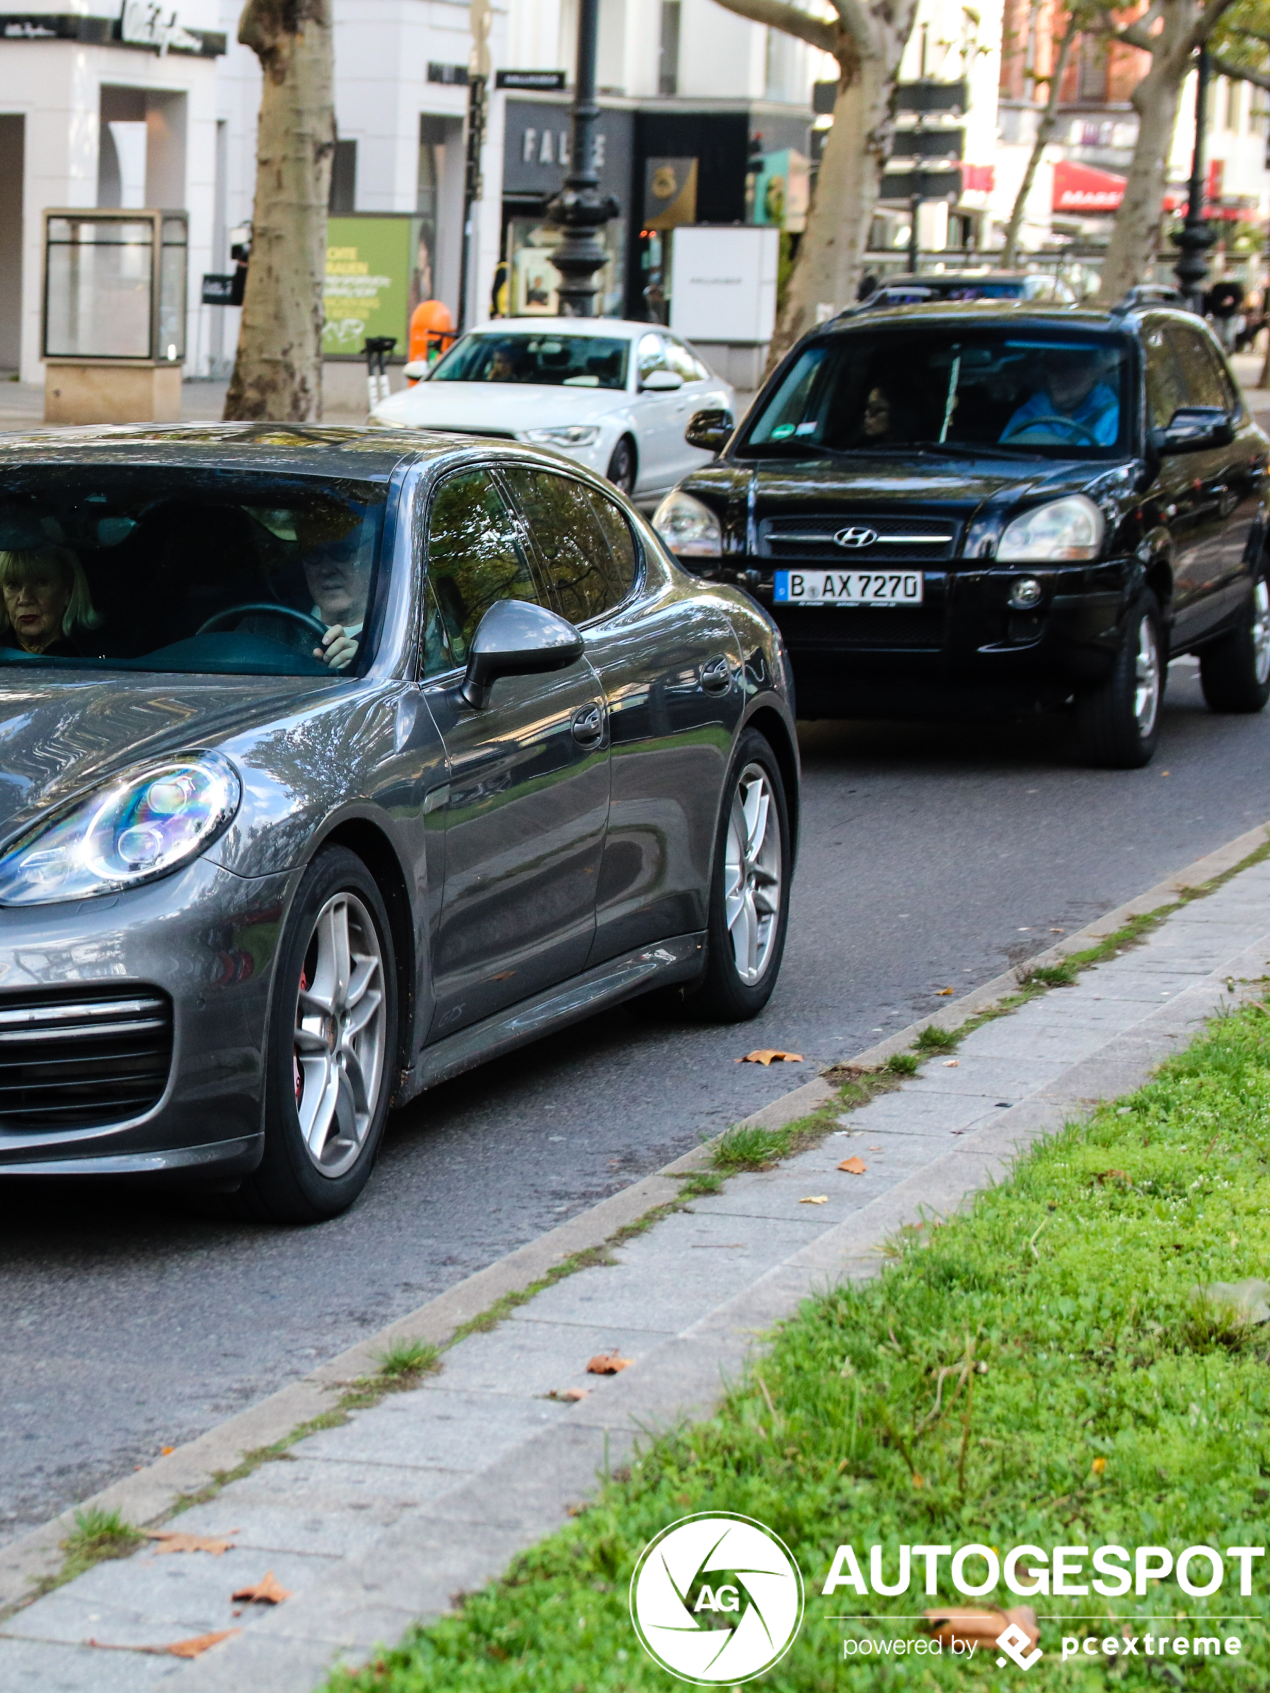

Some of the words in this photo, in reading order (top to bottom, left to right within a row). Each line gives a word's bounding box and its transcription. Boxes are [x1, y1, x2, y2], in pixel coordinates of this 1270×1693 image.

[523, 128, 606, 167] FALE
[791, 575, 805, 597] B
[822, 575, 852, 597] AX
[858, 575, 917, 597] 7270
